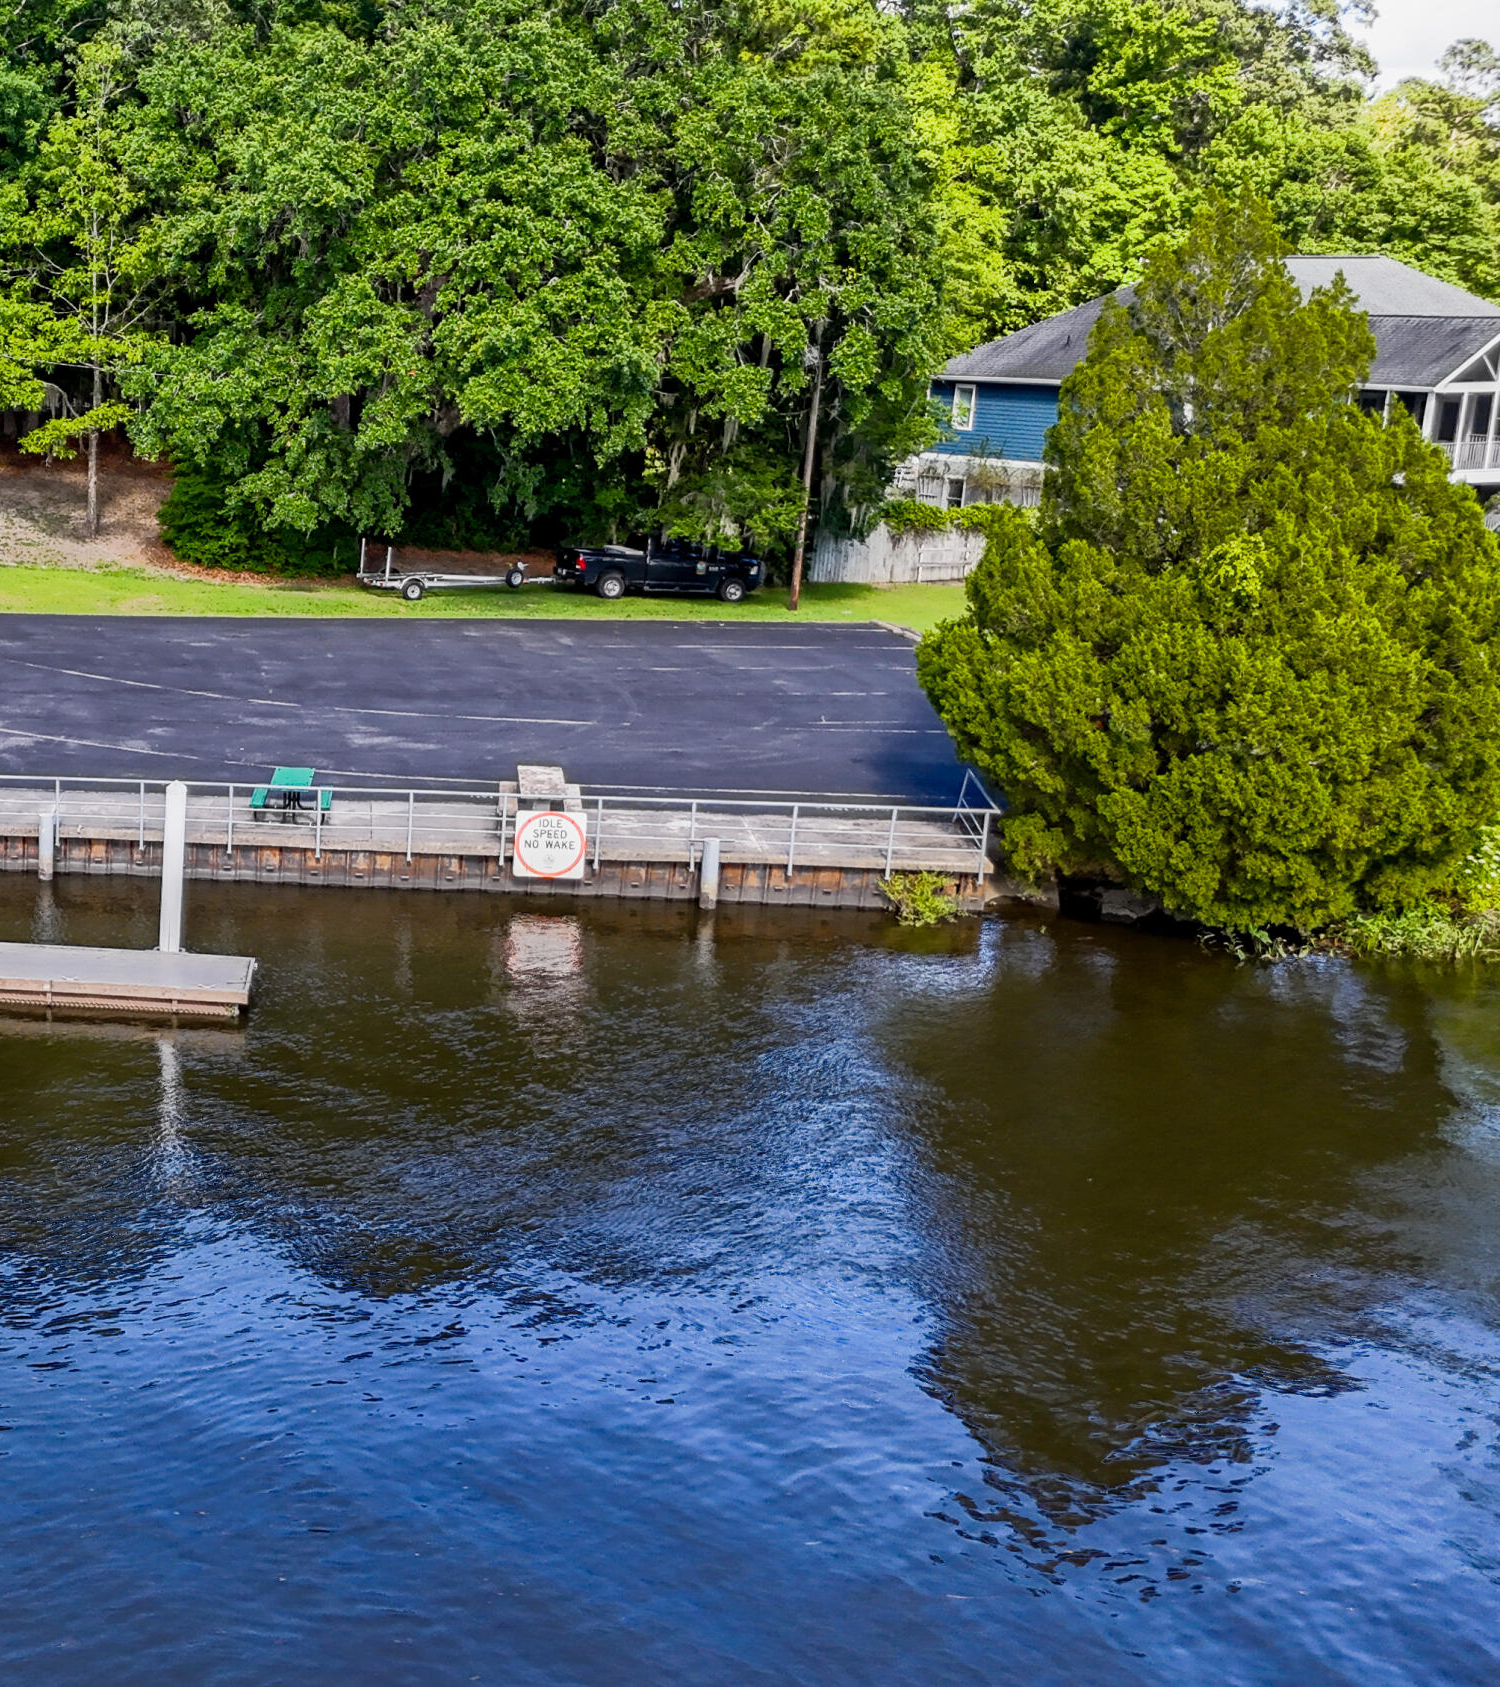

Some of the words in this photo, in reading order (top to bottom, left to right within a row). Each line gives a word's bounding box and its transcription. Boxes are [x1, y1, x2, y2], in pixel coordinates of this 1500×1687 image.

[539, 819, 563, 828] IDLE
[533, 829, 567, 839] SPEED
[524, 840, 539, 849] NO
[545, 841, 575, 850] WAKE
